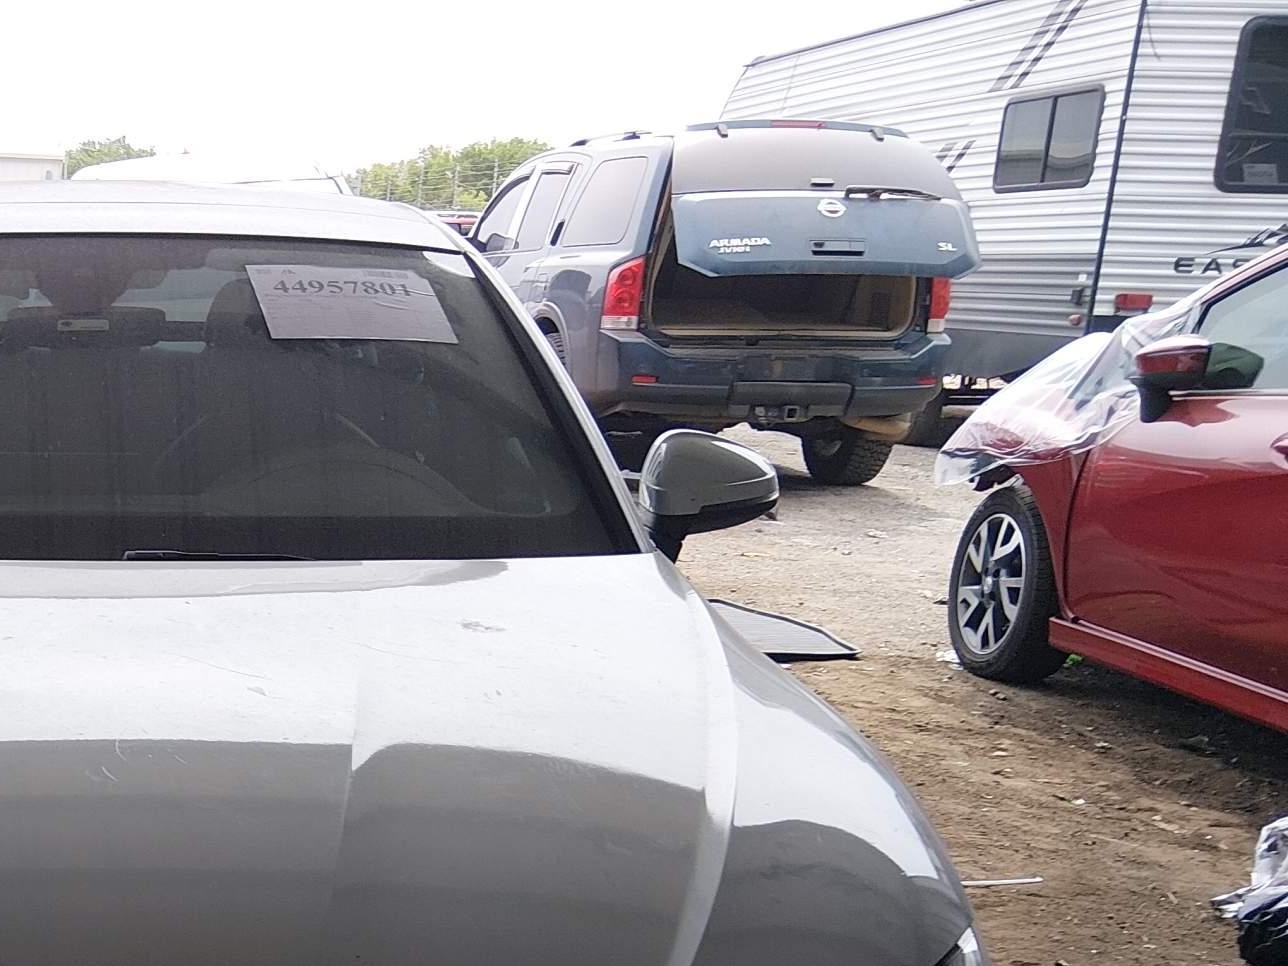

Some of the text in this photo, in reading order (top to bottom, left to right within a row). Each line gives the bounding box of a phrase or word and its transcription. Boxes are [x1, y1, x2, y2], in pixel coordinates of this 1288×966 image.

[709, 237, 771, 248] ARMADA
[937, 242, 958, 251] SL
[273, 279, 411, 297] 44957801
